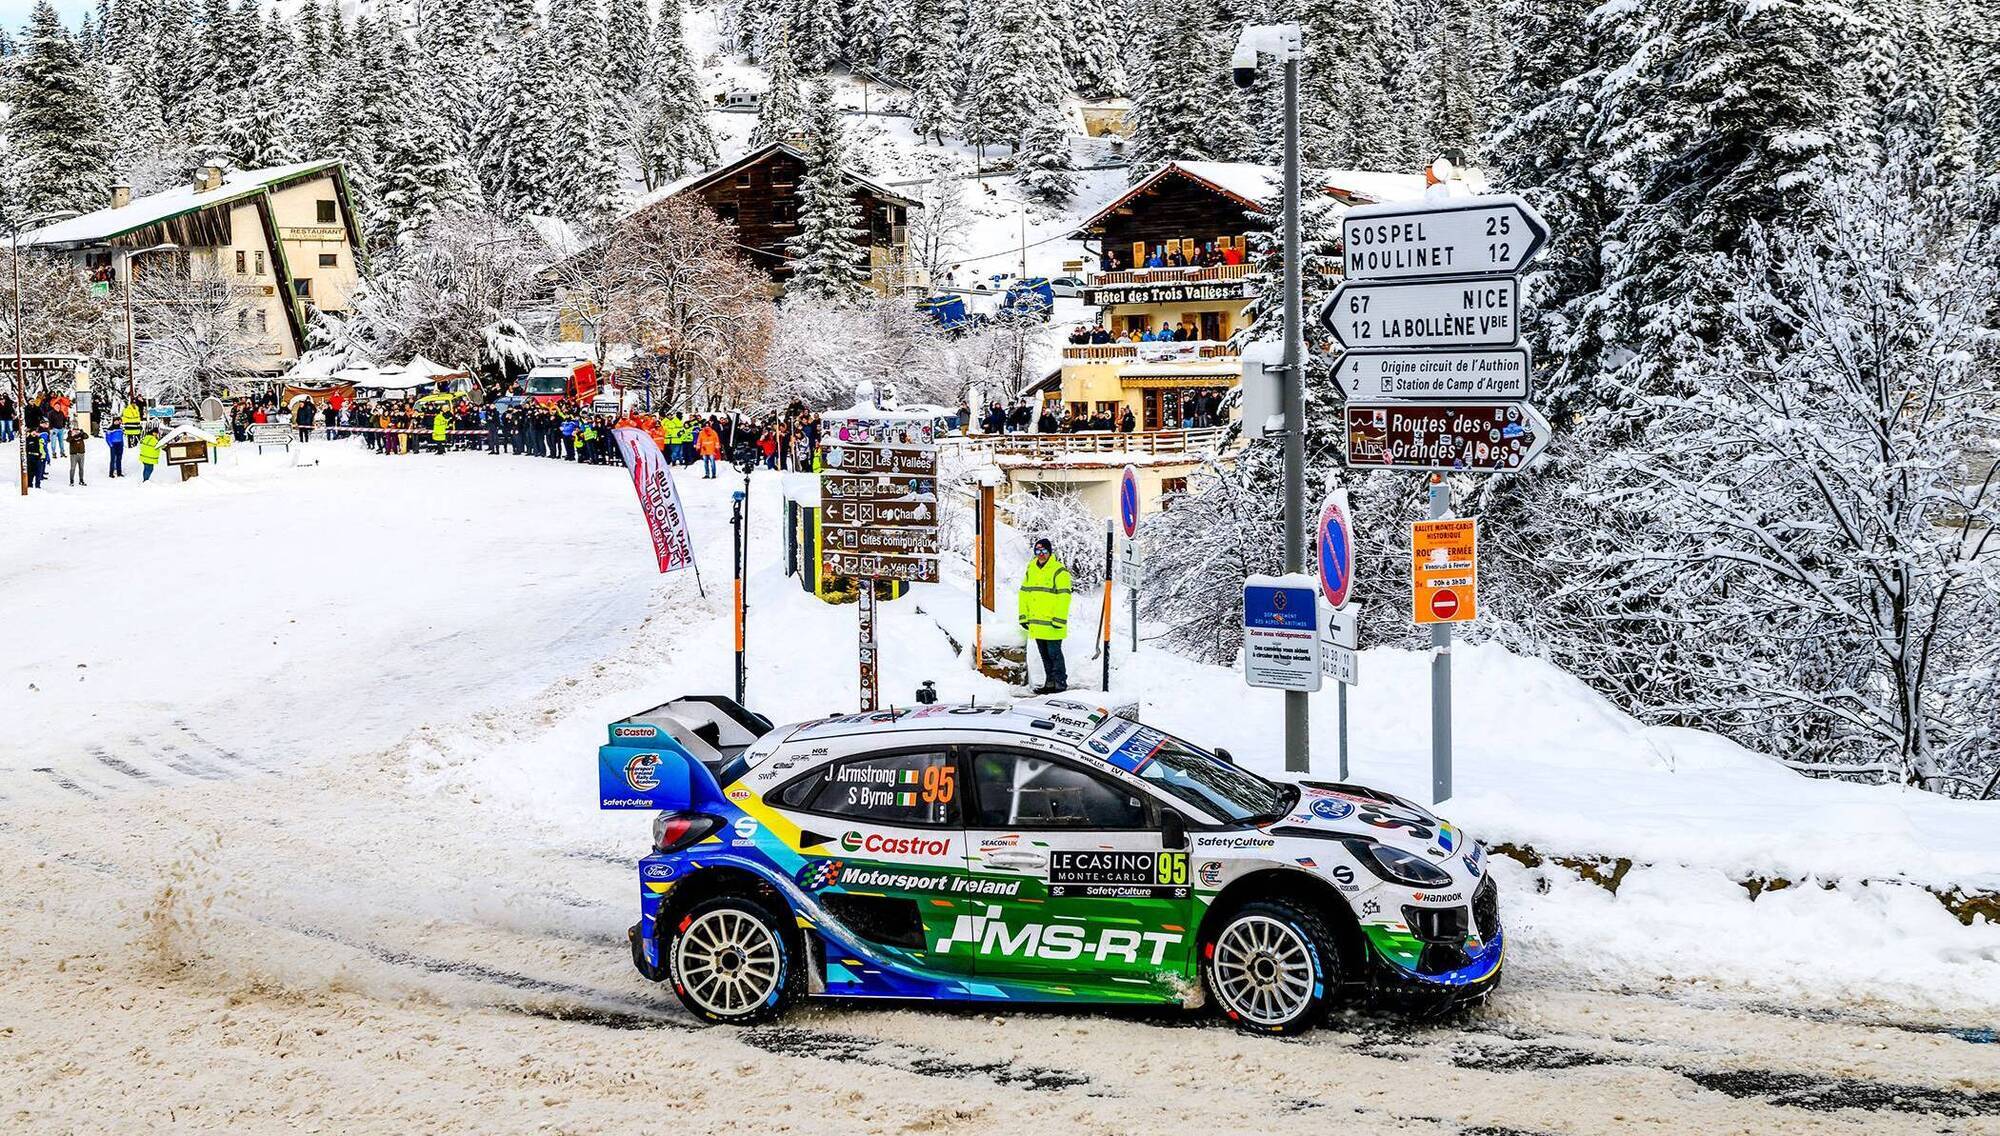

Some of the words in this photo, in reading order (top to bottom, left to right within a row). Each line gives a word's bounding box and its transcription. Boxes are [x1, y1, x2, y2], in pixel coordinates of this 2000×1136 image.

[1351, 223, 1426, 246] SOSPEL
[1486, 216, 1510, 237] 25
[1351, 246, 1454, 271] MOULINET
[1489, 243, 1510, 263] 12
[1094, 290, 1125, 304] Hôtel
[1129, 289, 1149, 303] des
[1150, 288, 1183, 301] Trois
[1185, 285, 1229, 299] Vallées
[1350, 296, 1370, 315] 67
[1463, 289, 1508, 310] NICE
[1352, 320, 1371, 339] 12
[1352, 361, 1359, 373] 4
[1381, 360, 1417, 376] Origine
[1419, 359, 1452, 373] circuit
[1456, 360, 1468, 373] de
[1471, 358, 1519, 372] l'Authion
[1352, 379, 1359, 391] 2
[1396, 378, 1431, 392] Station
[1433, 379, 1445, 391] de
[1446, 379, 1474, 394] Camp
[1476, 377, 1520, 394] d'Argent
[1392, 414, 1447, 433] Routes
[1453, 414, 1481, 433] des
[1354, 438, 1384, 459] Alpes
[1392, 440, 1456, 459] Grandes
[876, 455, 892, 466] Les
[893, 456, 899, 467] 3
[900, 455, 932, 469] Vallées
[1426, 532, 1461, 540] HISTORIQUE
[1435, 523, 1473, 531] MONTE-CARLO
[883, 536, 932, 548] communaux
[1447, 544, 1472, 556] ERMÉE
[623, 728, 655, 736] Castrol
[824, 763, 834, 782] J
[836, 765, 897, 788] Armstrong
[922, 766, 955, 804] 95
[603, 799, 654, 807] SafetyCulture
[848, 786, 858, 805] S
[860, 787, 894, 810] Byrne
[865, 832, 951, 857] Castrol
[1197, 837, 1275, 849] SafetyCulture
[648, 865, 668, 877] Ford
[1053, 854, 1072, 869] LE
[1075, 854, 1152, 870] CASINO
[1158, 853, 1187, 884] 95
[841, 867, 948, 891] Motorsport
[951, 876, 1020, 897] Ireland
[1086, 887, 1152, 896] SafetyCulture
[981, 921, 1184, 966] MS-RT
